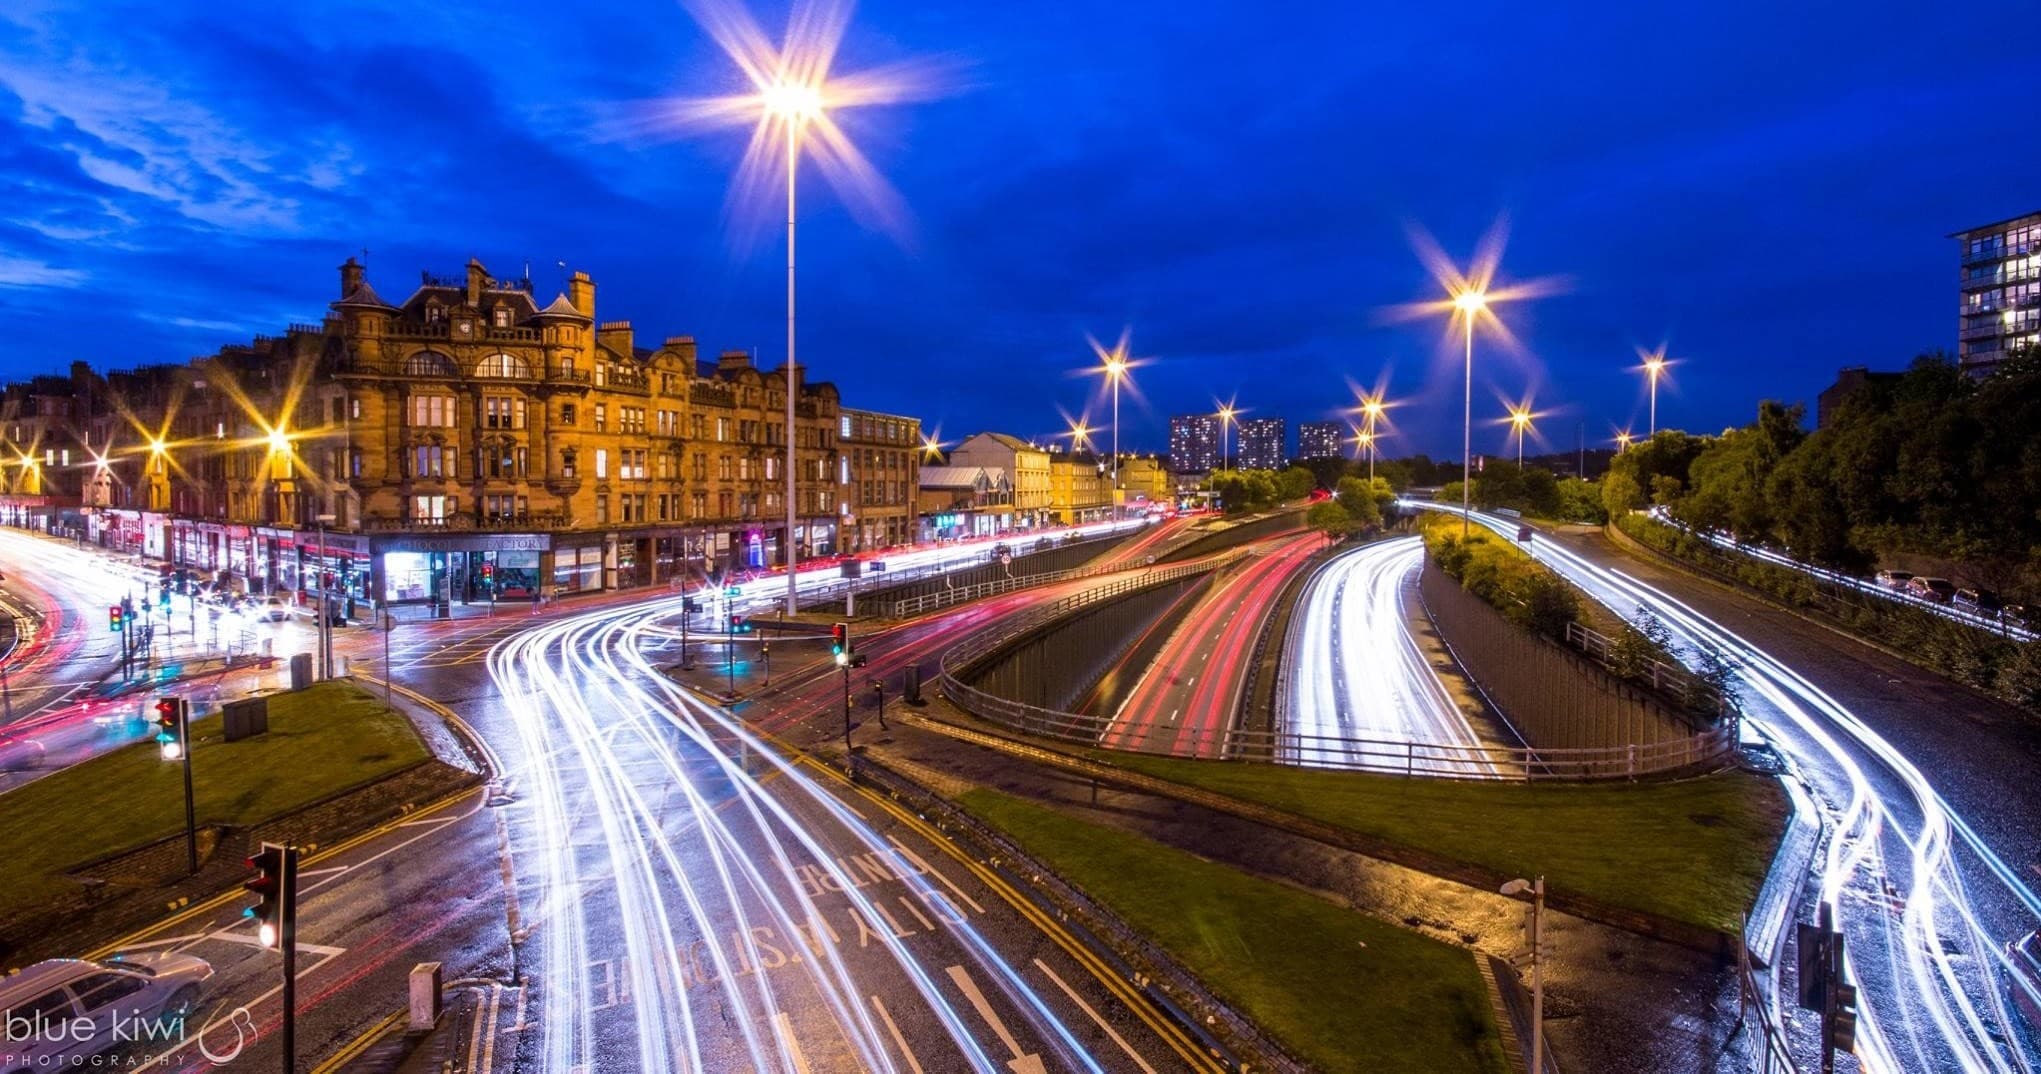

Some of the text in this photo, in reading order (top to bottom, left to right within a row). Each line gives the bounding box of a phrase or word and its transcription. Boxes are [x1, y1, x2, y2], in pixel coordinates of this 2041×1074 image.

[400, 539, 478, 551] CHOCOL
[486, 538, 544, 550] FACTORY
[849, 890, 968, 948] CITY
